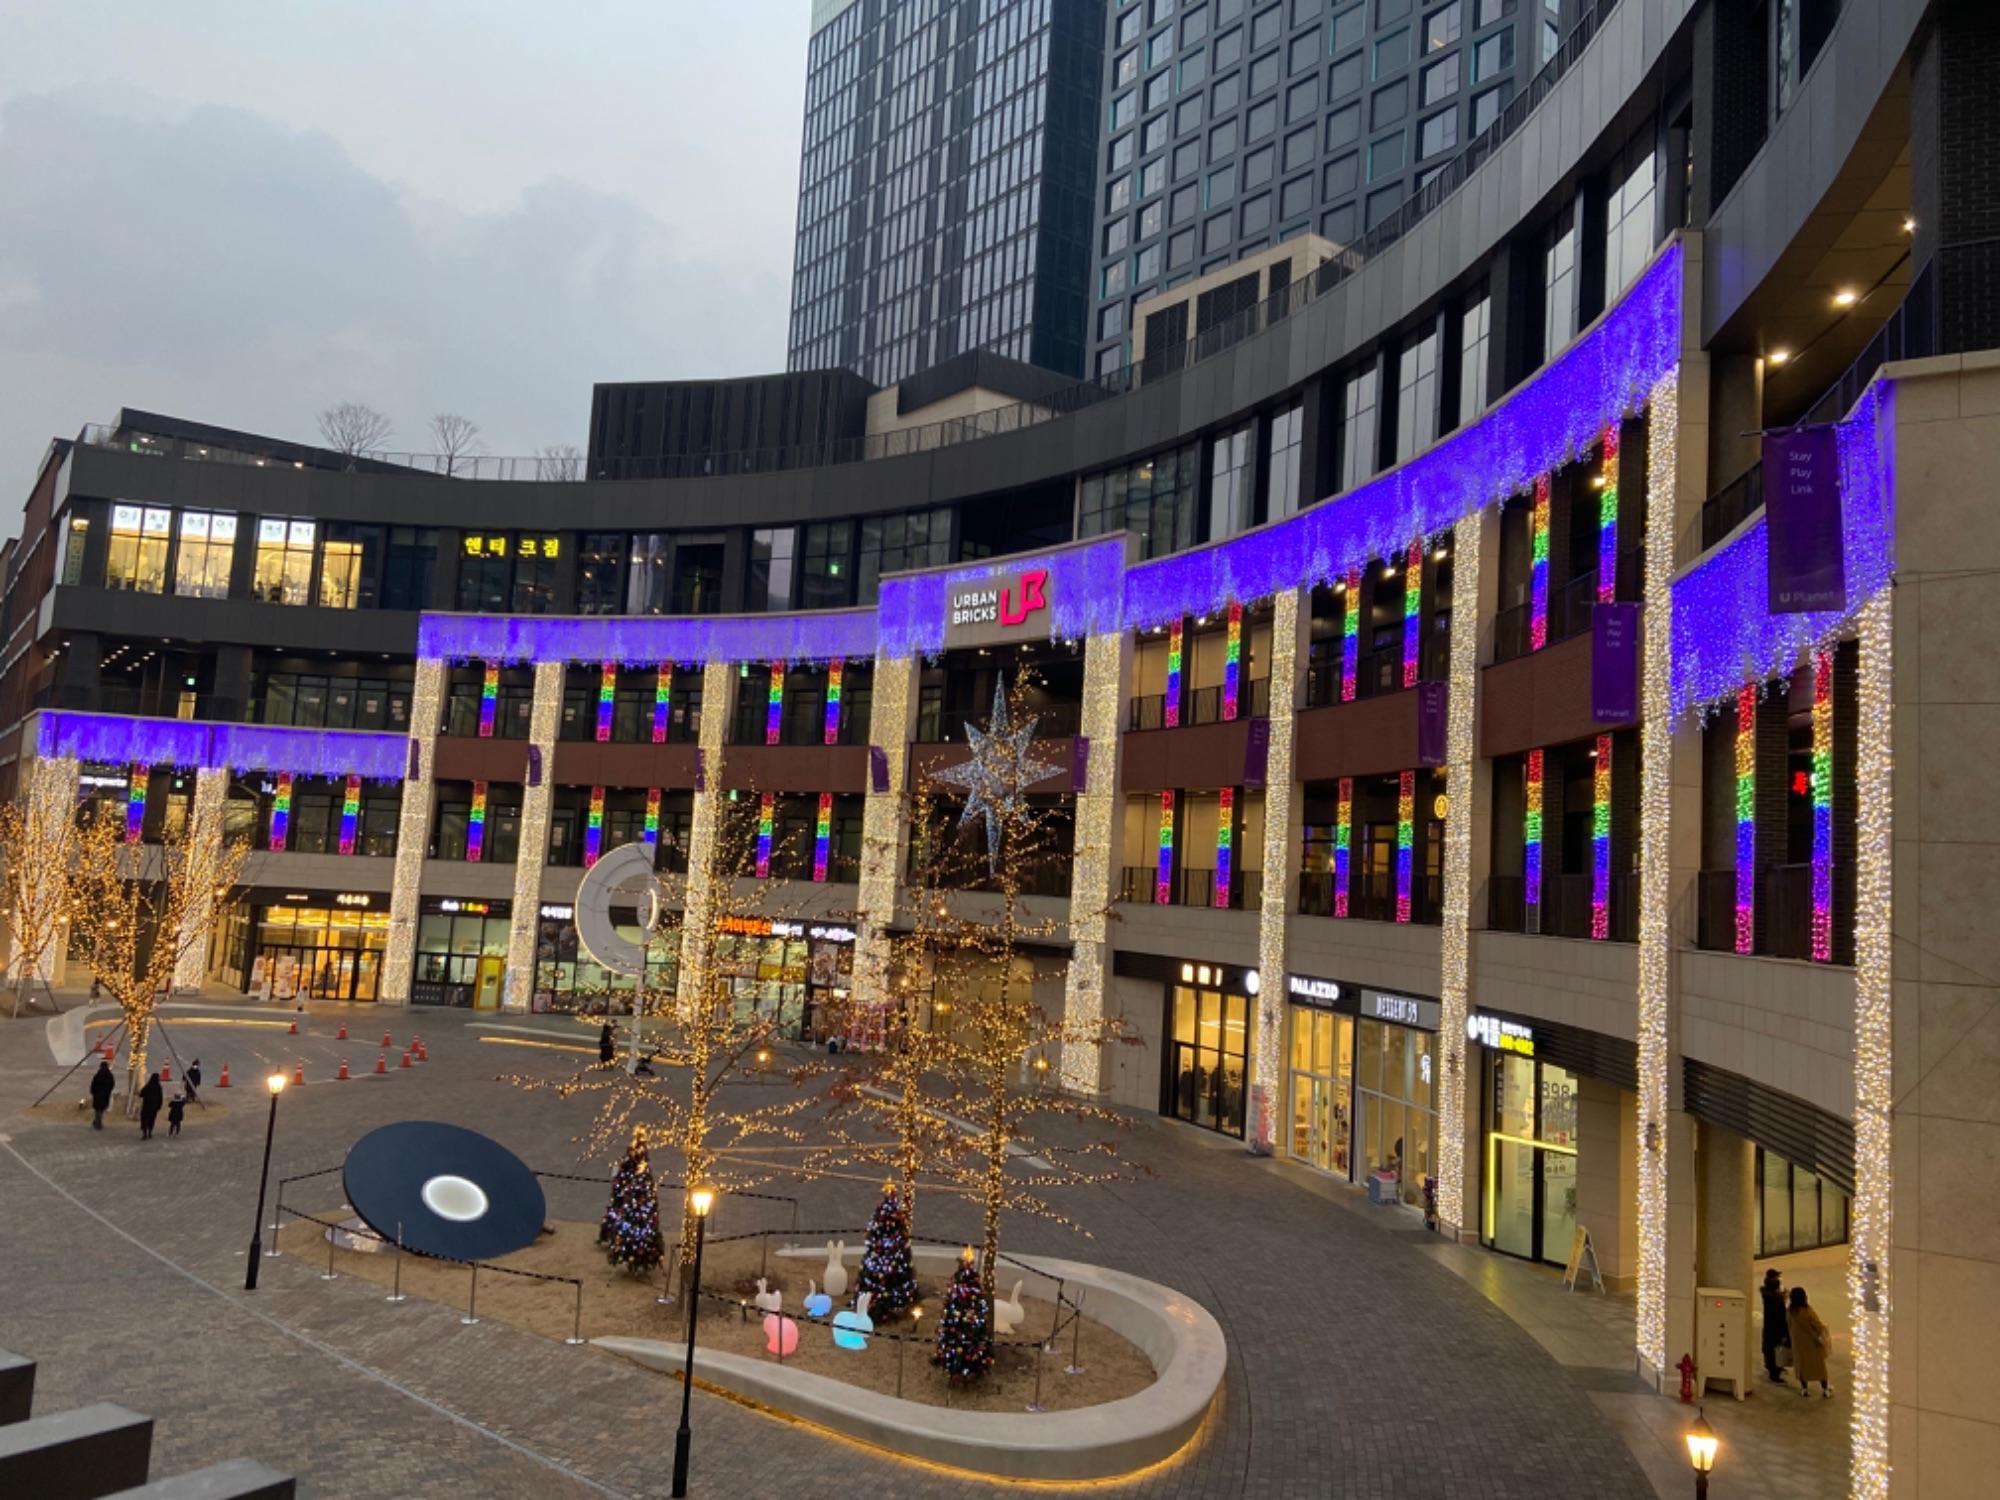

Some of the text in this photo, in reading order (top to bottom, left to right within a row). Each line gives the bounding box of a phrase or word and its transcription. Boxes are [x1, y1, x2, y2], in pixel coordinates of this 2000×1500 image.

[1789, 452, 1812, 466] Stay
[1790, 468, 1812, 479] Play
[1791, 484, 1813, 495] Link
[953, 590, 997, 608] URBAN
[953, 606, 997, 624] BRICKS
[1290, 976, 1340, 1001] PALAZZO
